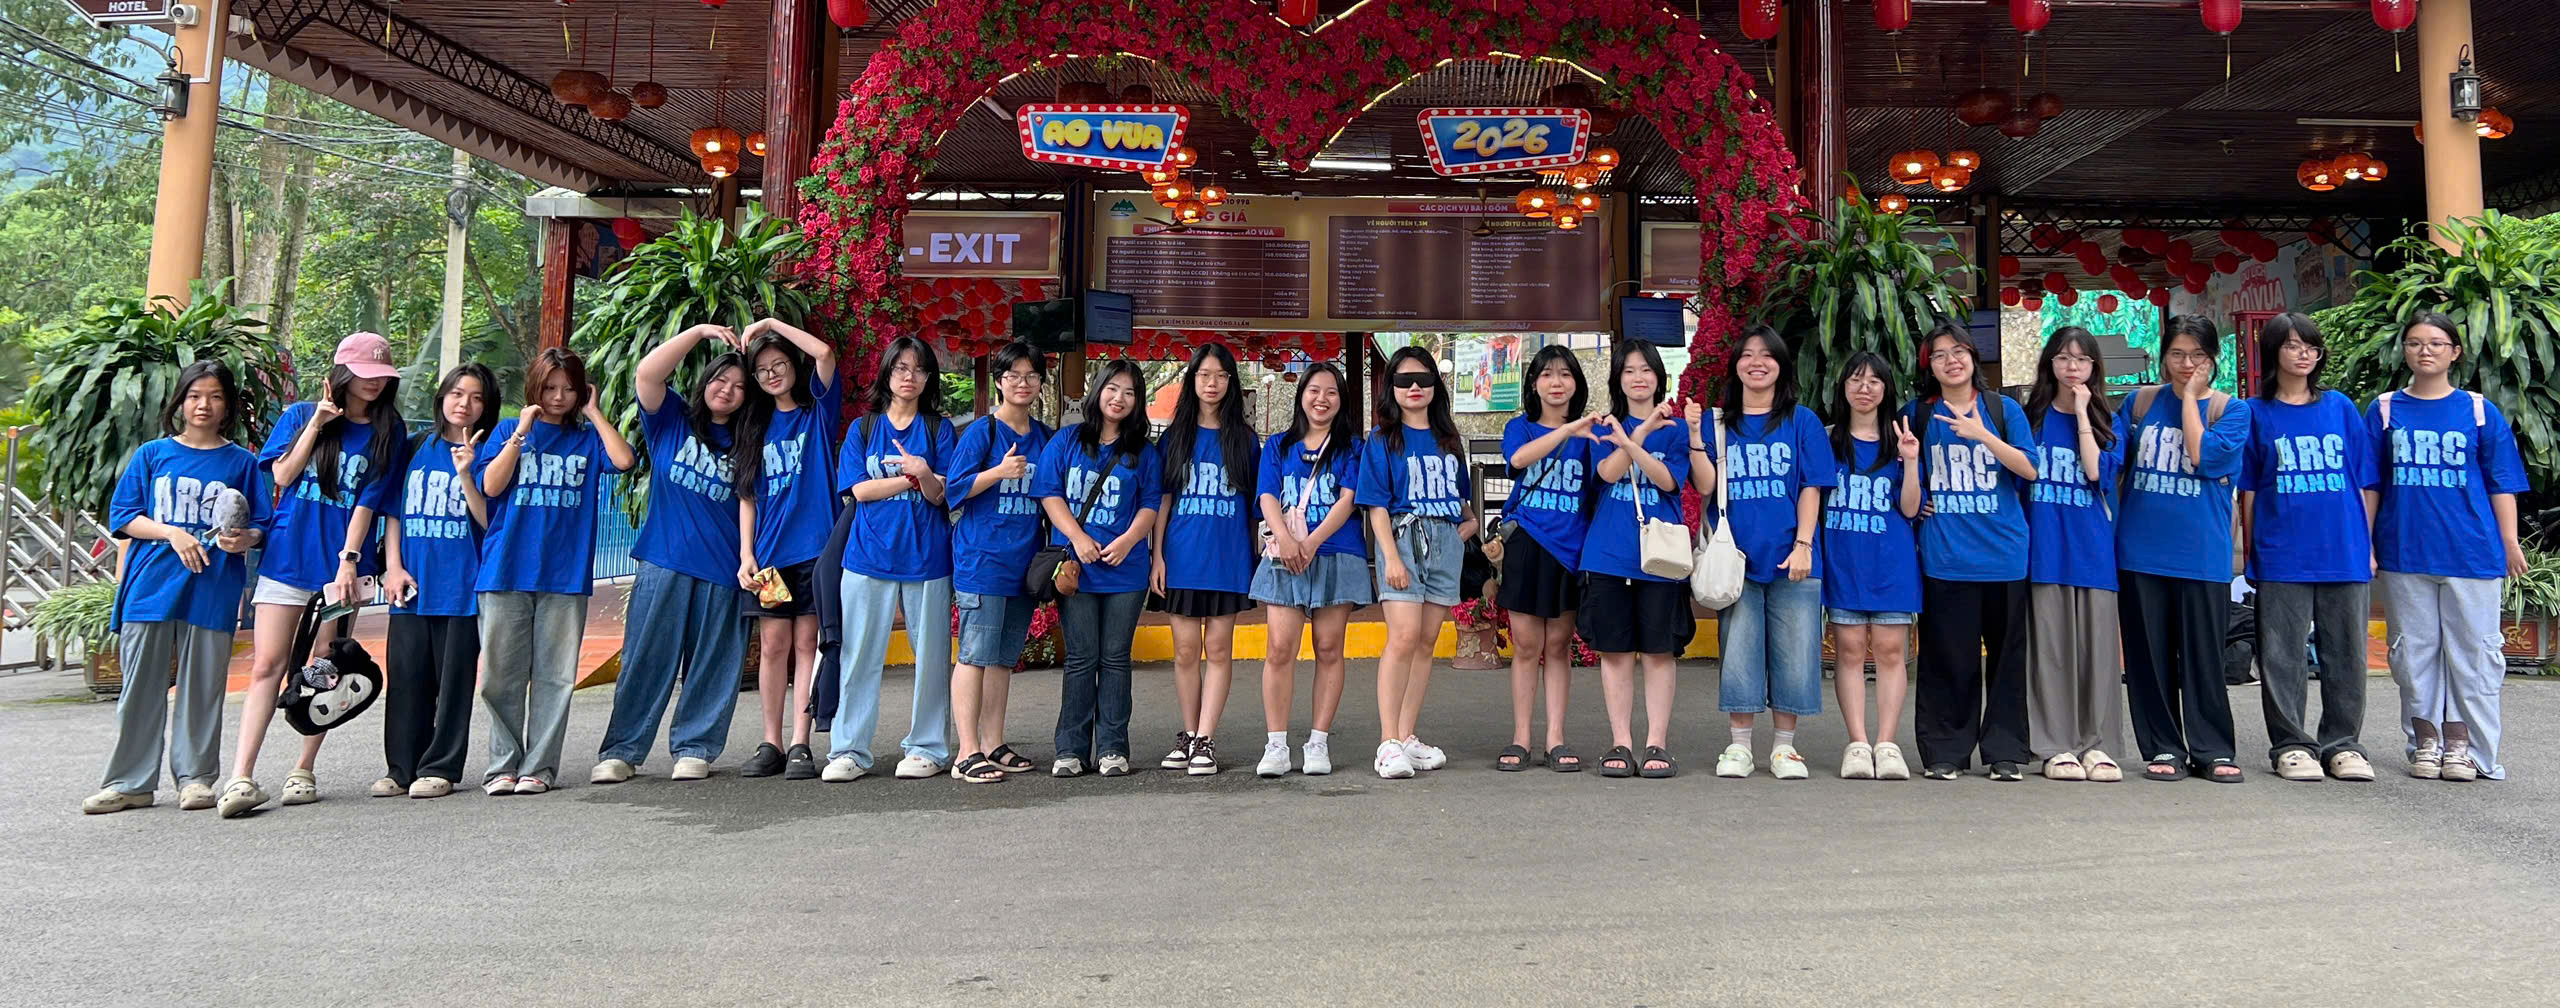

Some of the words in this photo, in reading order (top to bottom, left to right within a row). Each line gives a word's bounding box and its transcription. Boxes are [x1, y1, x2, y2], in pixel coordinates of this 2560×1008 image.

[108, 1, 148, 12] HOTEL
[1042, 118, 1092, 147] AO
[1102, 119, 1164, 150] VUA
[1453, 118, 1550, 157] 2026
[1219, 208, 1247, 222] GIÁ
[929, 233, 1020, 264] EXIT
[1727, 441, 1792, 479] ARC
[2275, 433, 2343, 472] ARC
[2392, 426, 2467, 466] ARC
[518, 448, 587, 488] ARC
[1407, 451, 1460, 500] ARC
[1522, 457, 1584, 493] ARC
[1930, 440, 1998, 492] ARC
[2393, 466, 2467, 488] HANOI
[406, 465, 466, 517] ARC
[515, 488, 581, 509] HANOI
[670, 464, 731, 503] HANOI
[1828, 469, 1891, 512] ARC
[2030, 483, 2092, 508] HANOI
[2134, 471, 2201, 498] HANOI
[2276, 474, 2345, 493] HANOI
[1178, 498, 1236, 518] HANOI
[1520, 489, 1579, 513] HANOI
[1933, 494, 1998, 514] HANOI
[406, 518, 467, 540] HANOI
